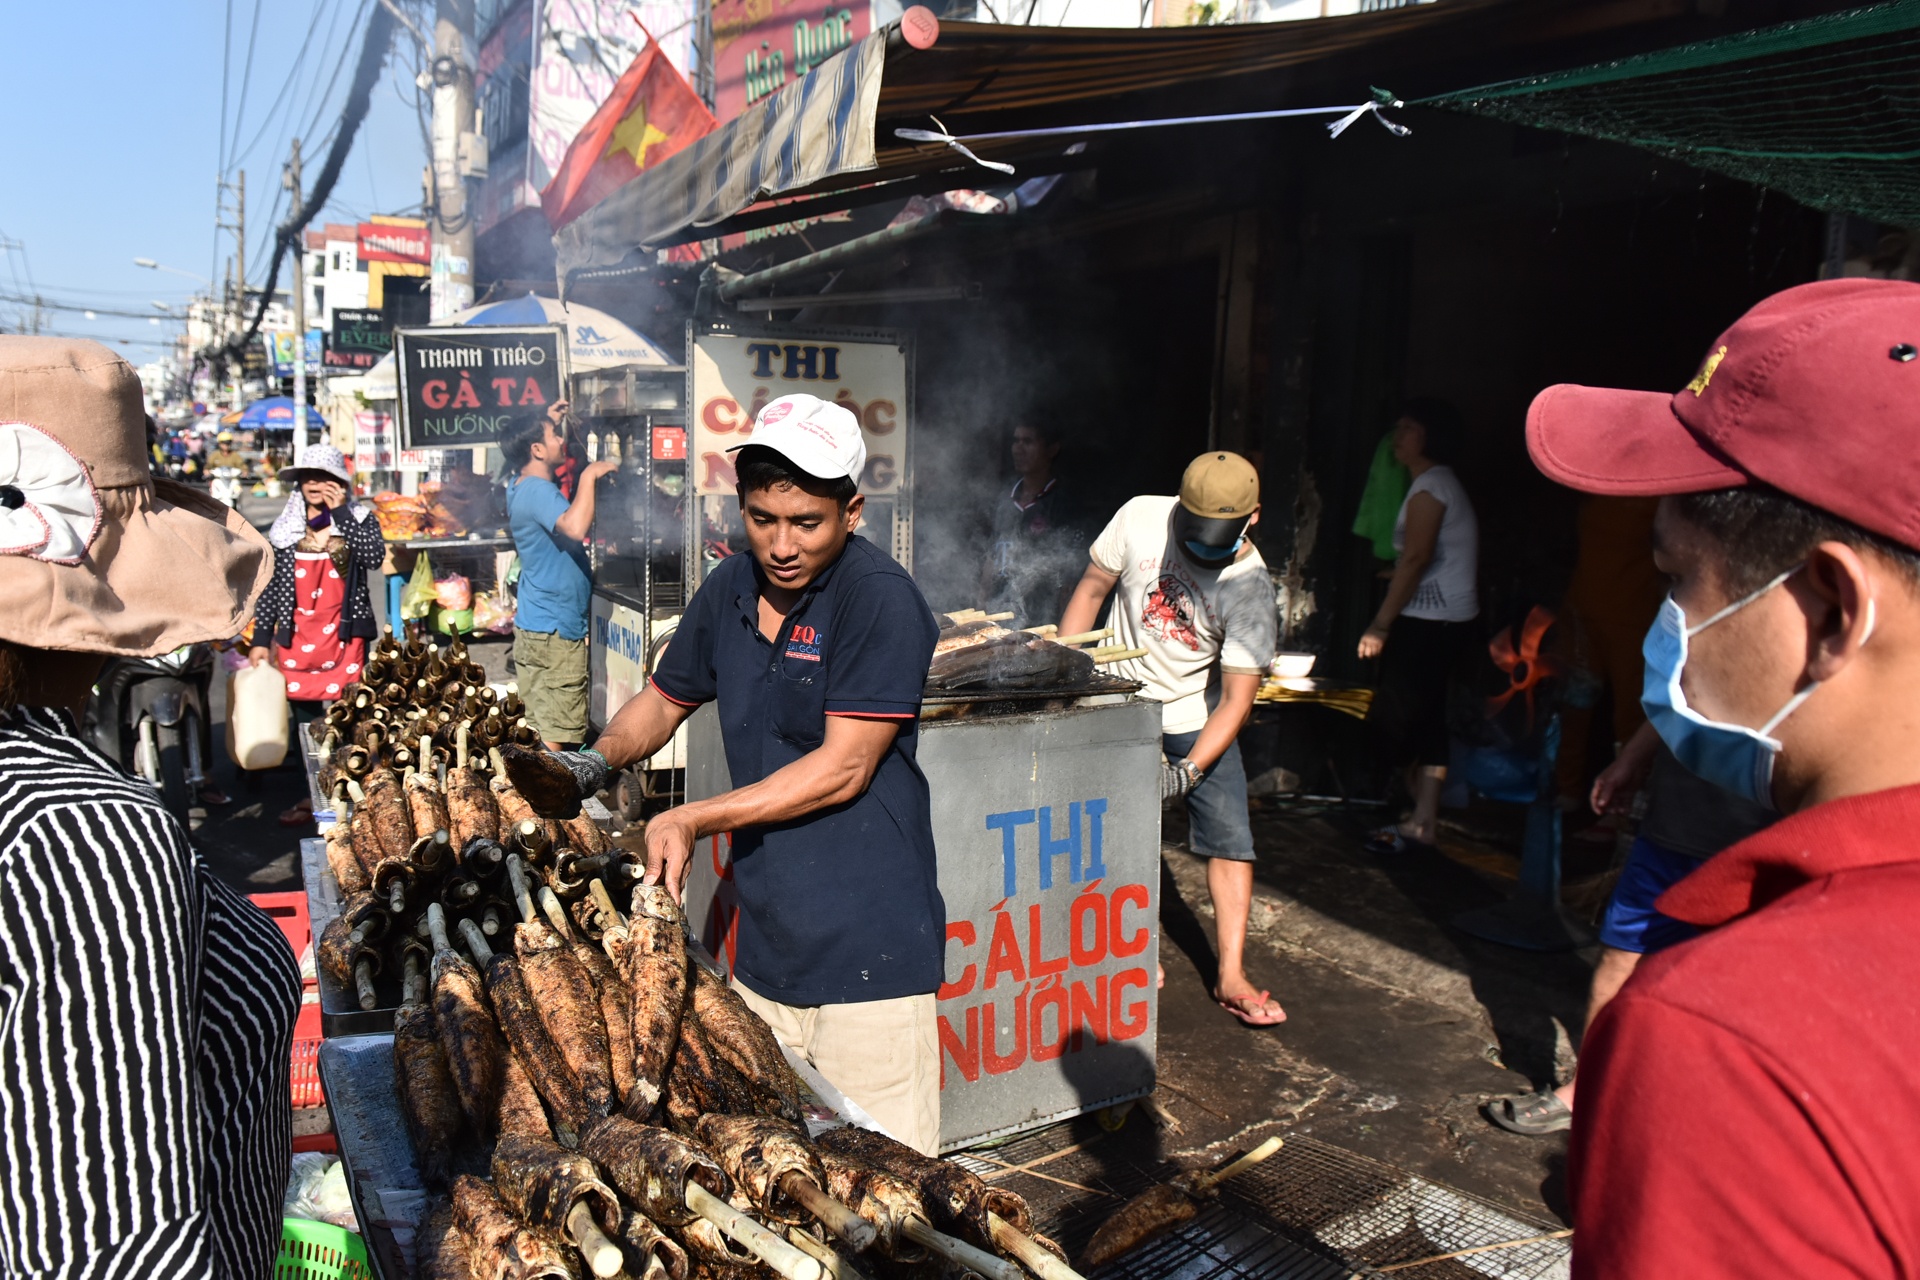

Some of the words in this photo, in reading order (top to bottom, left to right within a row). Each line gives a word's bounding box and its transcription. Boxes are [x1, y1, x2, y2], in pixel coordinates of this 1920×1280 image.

[417, 348, 483, 369] THANH
[744, 340, 842, 382] THI
[421, 370, 481, 410] GÀ
[491, 376, 547, 406] TA
[596, 615, 621, 654] THANH
[985, 797, 1108, 897] THI
[936, 967, 1149, 1092] NƯỚNG
